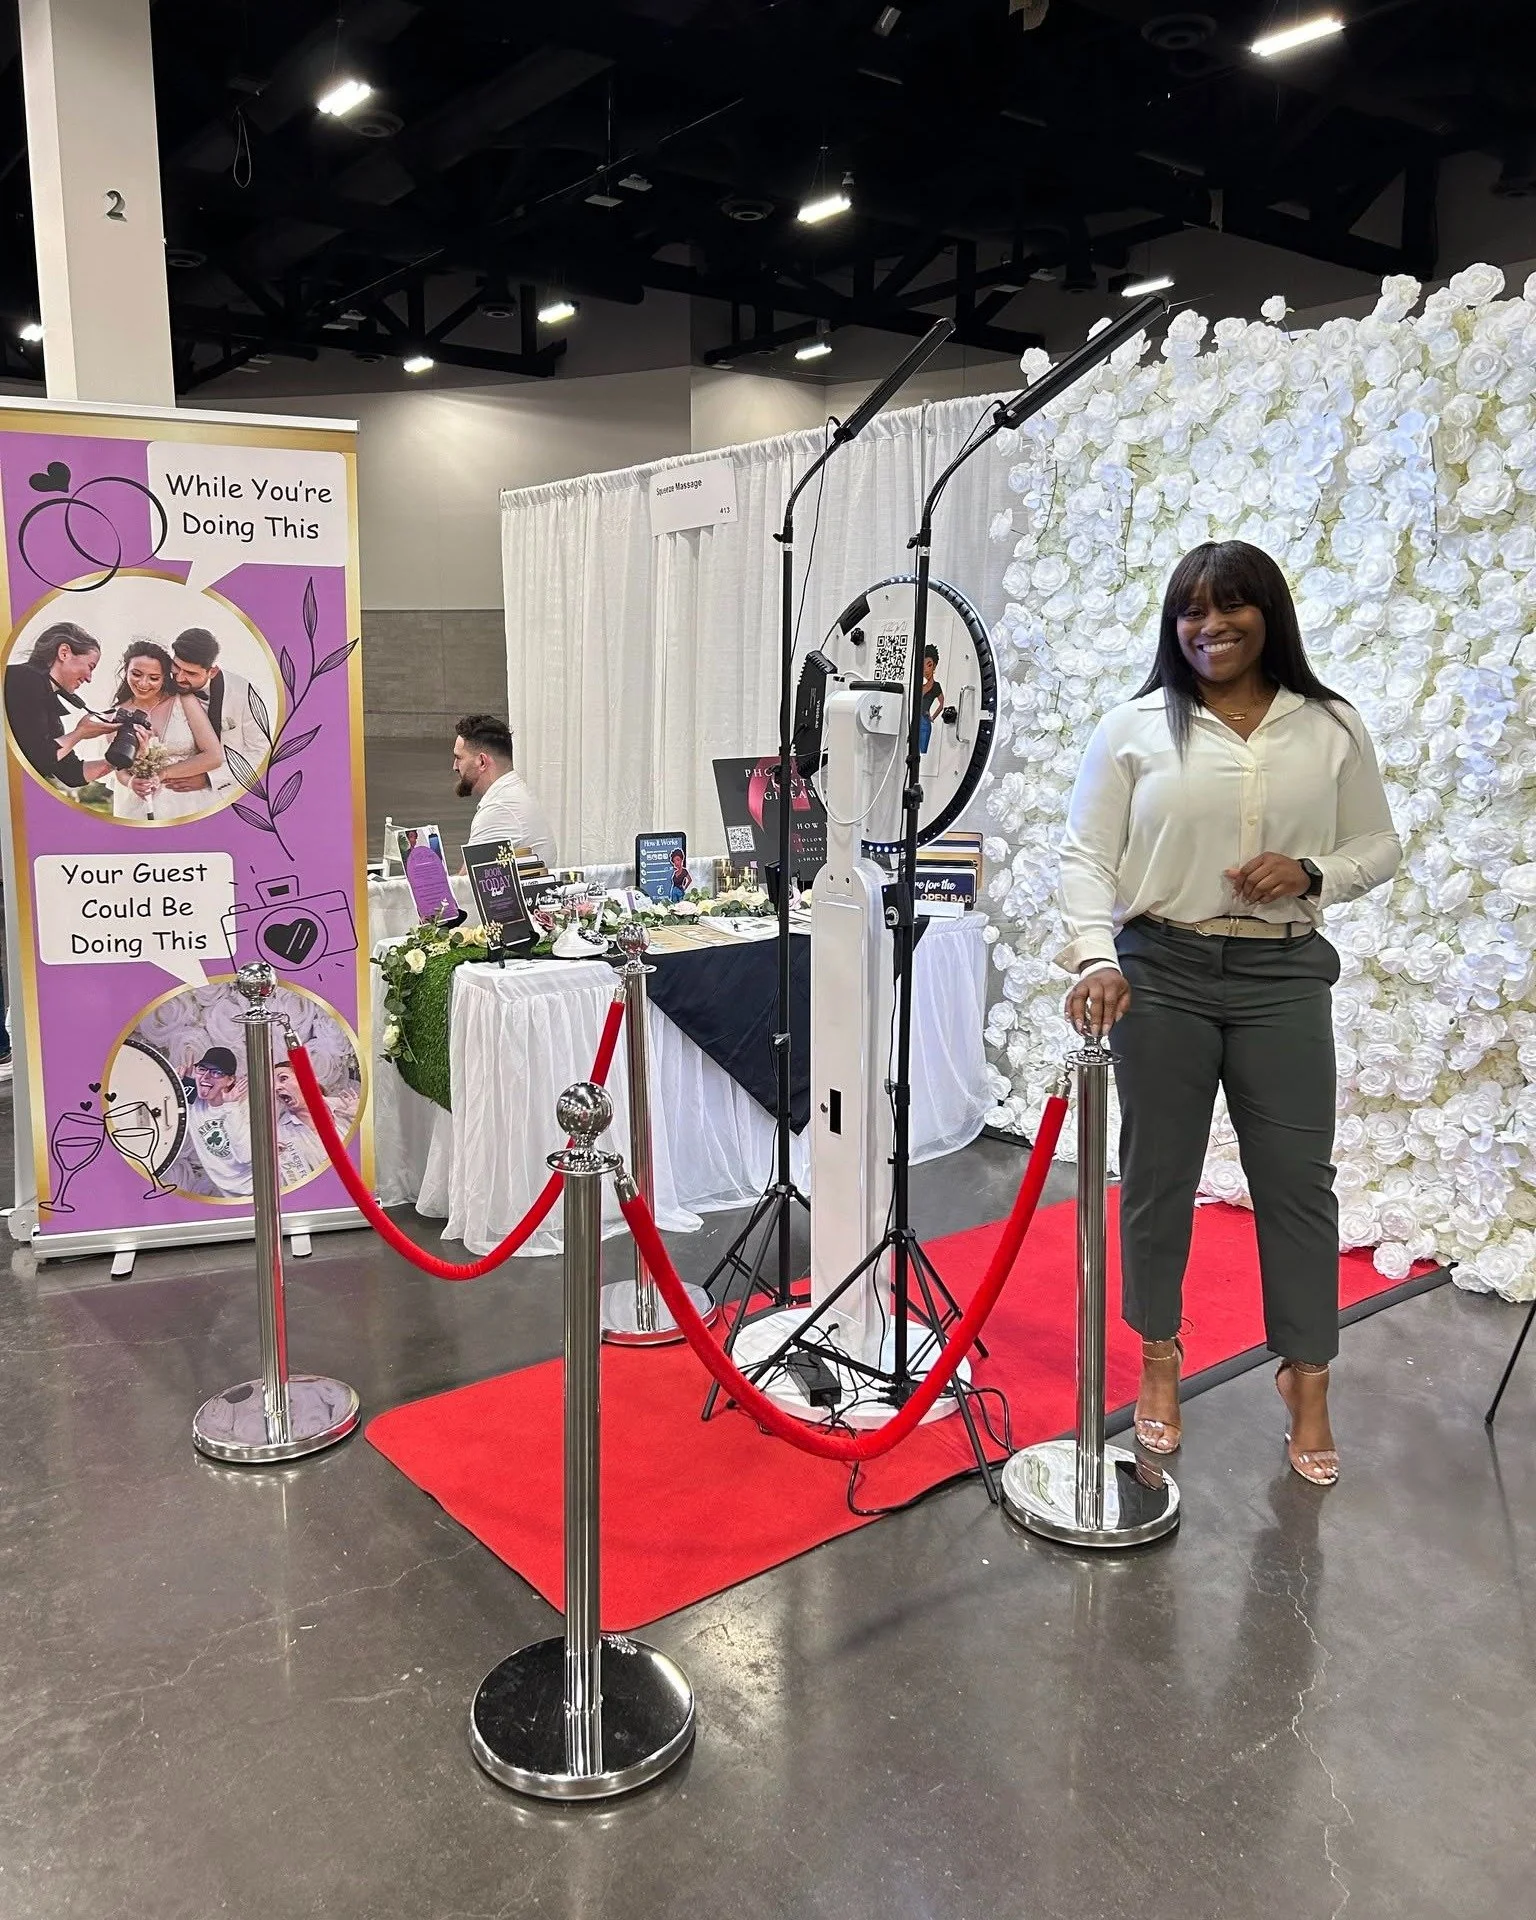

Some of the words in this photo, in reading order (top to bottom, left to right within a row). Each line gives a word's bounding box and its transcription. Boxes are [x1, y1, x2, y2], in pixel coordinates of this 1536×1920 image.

[106, 190, 127, 222] 2
[166, 473, 243, 499] While
[251, 478, 332, 503] You're
[656, 486, 674, 496] Squeeze
[675, 479, 702, 490] Massage
[719, 506, 731, 514] 413
[182, 511, 254, 543] Doing
[264, 516, 319, 539] This
[796, 822, 819, 830] HOW
[661, 838, 679, 846] Works
[61, 864, 123, 884] Your
[133, 863, 207, 884] Guest
[479, 875, 511, 892] TODAY
[925, 879, 940, 893] for
[940, 879, 957, 890] the
[920, 893, 948, 901] OPEN
[950, 893, 973, 903] BAR
[82, 897, 151, 919] Could
[163, 896, 194, 916] Be
[71, 933, 143, 958] Doing
[152, 930, 207, 951] This
